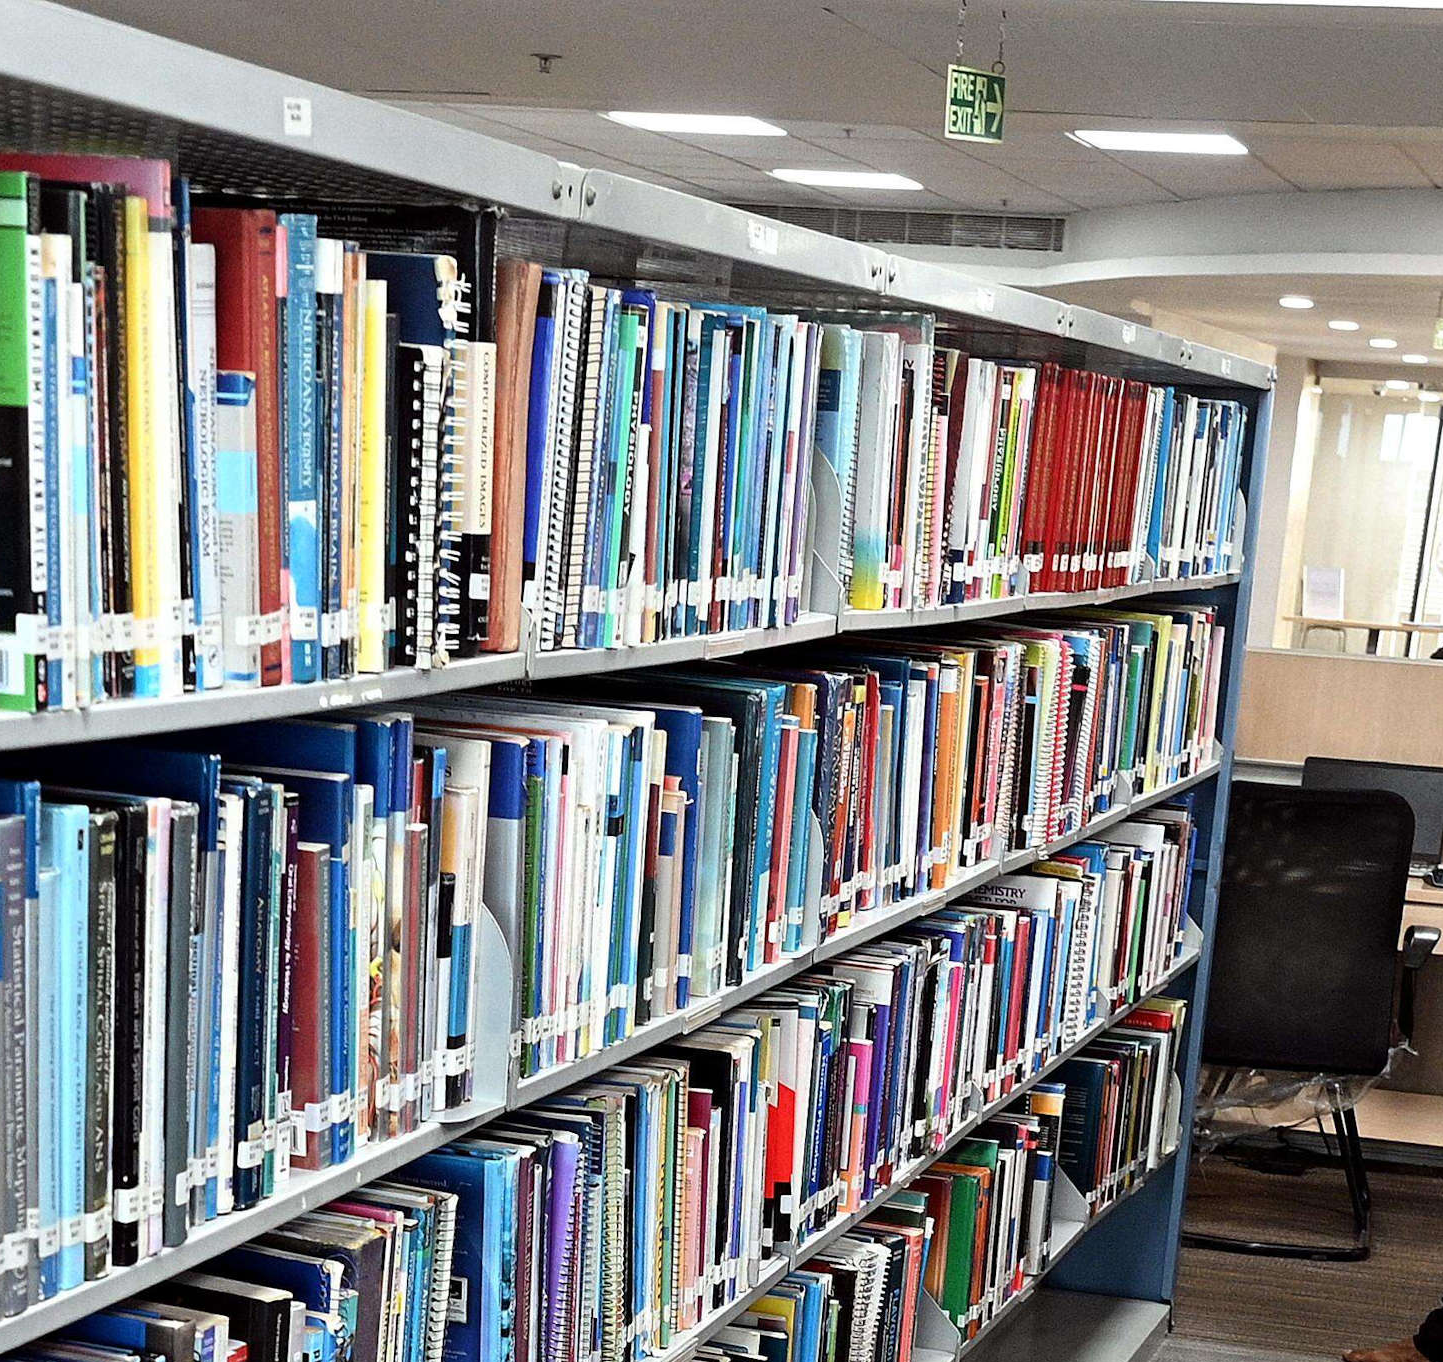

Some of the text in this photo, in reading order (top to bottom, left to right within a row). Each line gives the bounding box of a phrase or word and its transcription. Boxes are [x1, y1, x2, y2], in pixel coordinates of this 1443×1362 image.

[948, 105, 973, 134] EXIT
[951, 71, 974, 101] FIRE
[30, 248, 46, 583] NEUROANATOMY TEXT AND ATLAS
[209, 347, 218, 514] NEUROANATOMY
[302, 308, 313, 488] NEUROANATOMY
[479, 352, 491, 529] COMPUTERIZED IMAGES
[199, 369, 211, 559] NEUROLOGIC EXAM
[623, 390, 640, 517] PHYSIOLOGY
[991, 427, 1007, 512] PHYSIOLOGY
[330, 432, 340, 581] HUMAN BRAIN
[11, 924, 25, 1026] Statistical
[95, 946, 106, 1008] SPINAL
[255, 896, 265, 973] ANATOMY
[282, 863, 295, 1015] Oral Embryology Histology
[133, 973, 143, 1016] Brain
[133, 1020, 142, 1050] and
[13, 1029, 27, 1133] Parametric
[95, 1082, 104, 1121] AND
[131, 1053, 142, 1104] Spinal
[811, 1053, 828, 1183] Human Physiology
[94, 1126, 105, 1174] ANS
[522, 1252, 534, 1342] physiology
